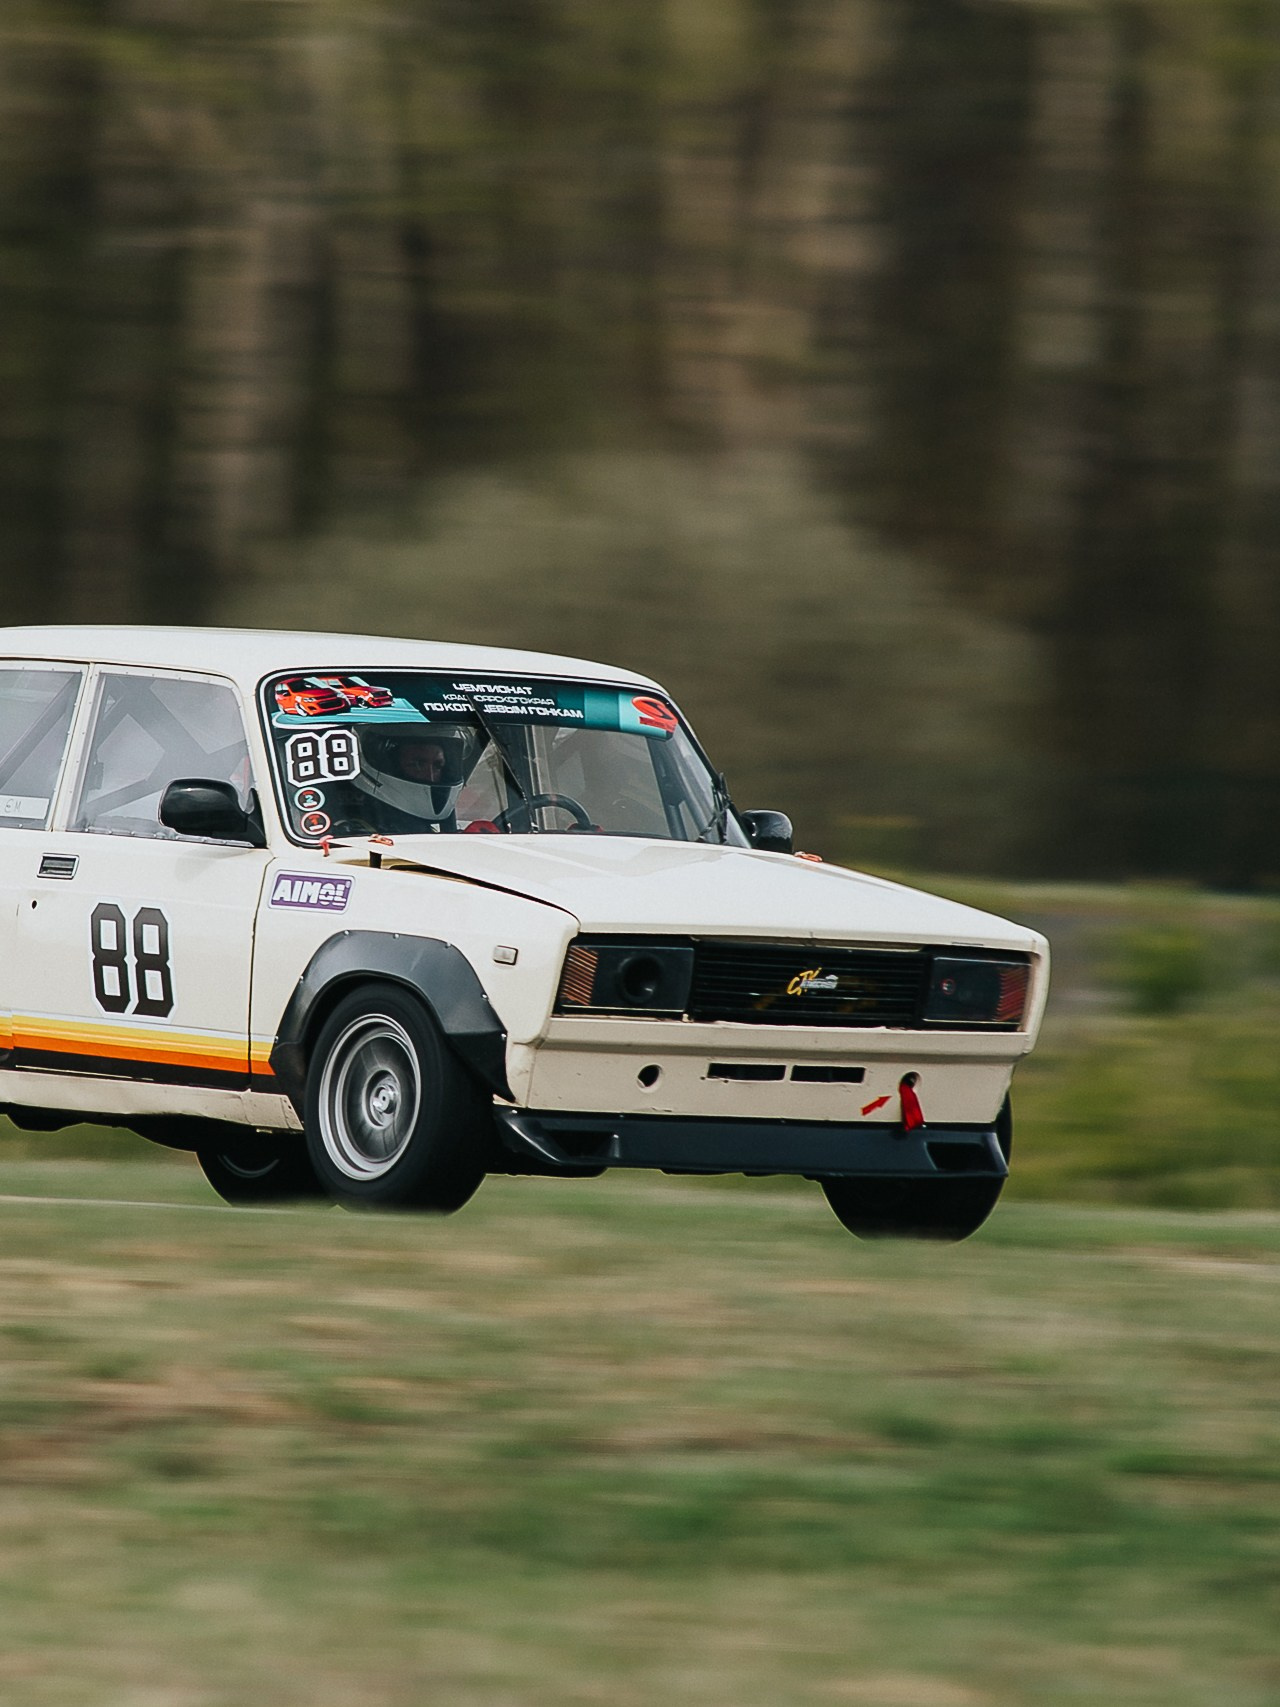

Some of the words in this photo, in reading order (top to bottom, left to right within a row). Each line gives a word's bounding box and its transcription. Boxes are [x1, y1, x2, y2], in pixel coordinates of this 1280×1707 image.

[452, 683, 533, 695] ЧЕМПИОНАТ
[423, 702, 444, 712] ПО
[445, 703, 528, 715] КОЛЦЕВЫМ
[529, 706, 584, 719] ГОНКАМ
[285, 730, 360, 788] 88
[273, 878, 347, 908] AIMOL
[91, 902, 175, 1018] 88
